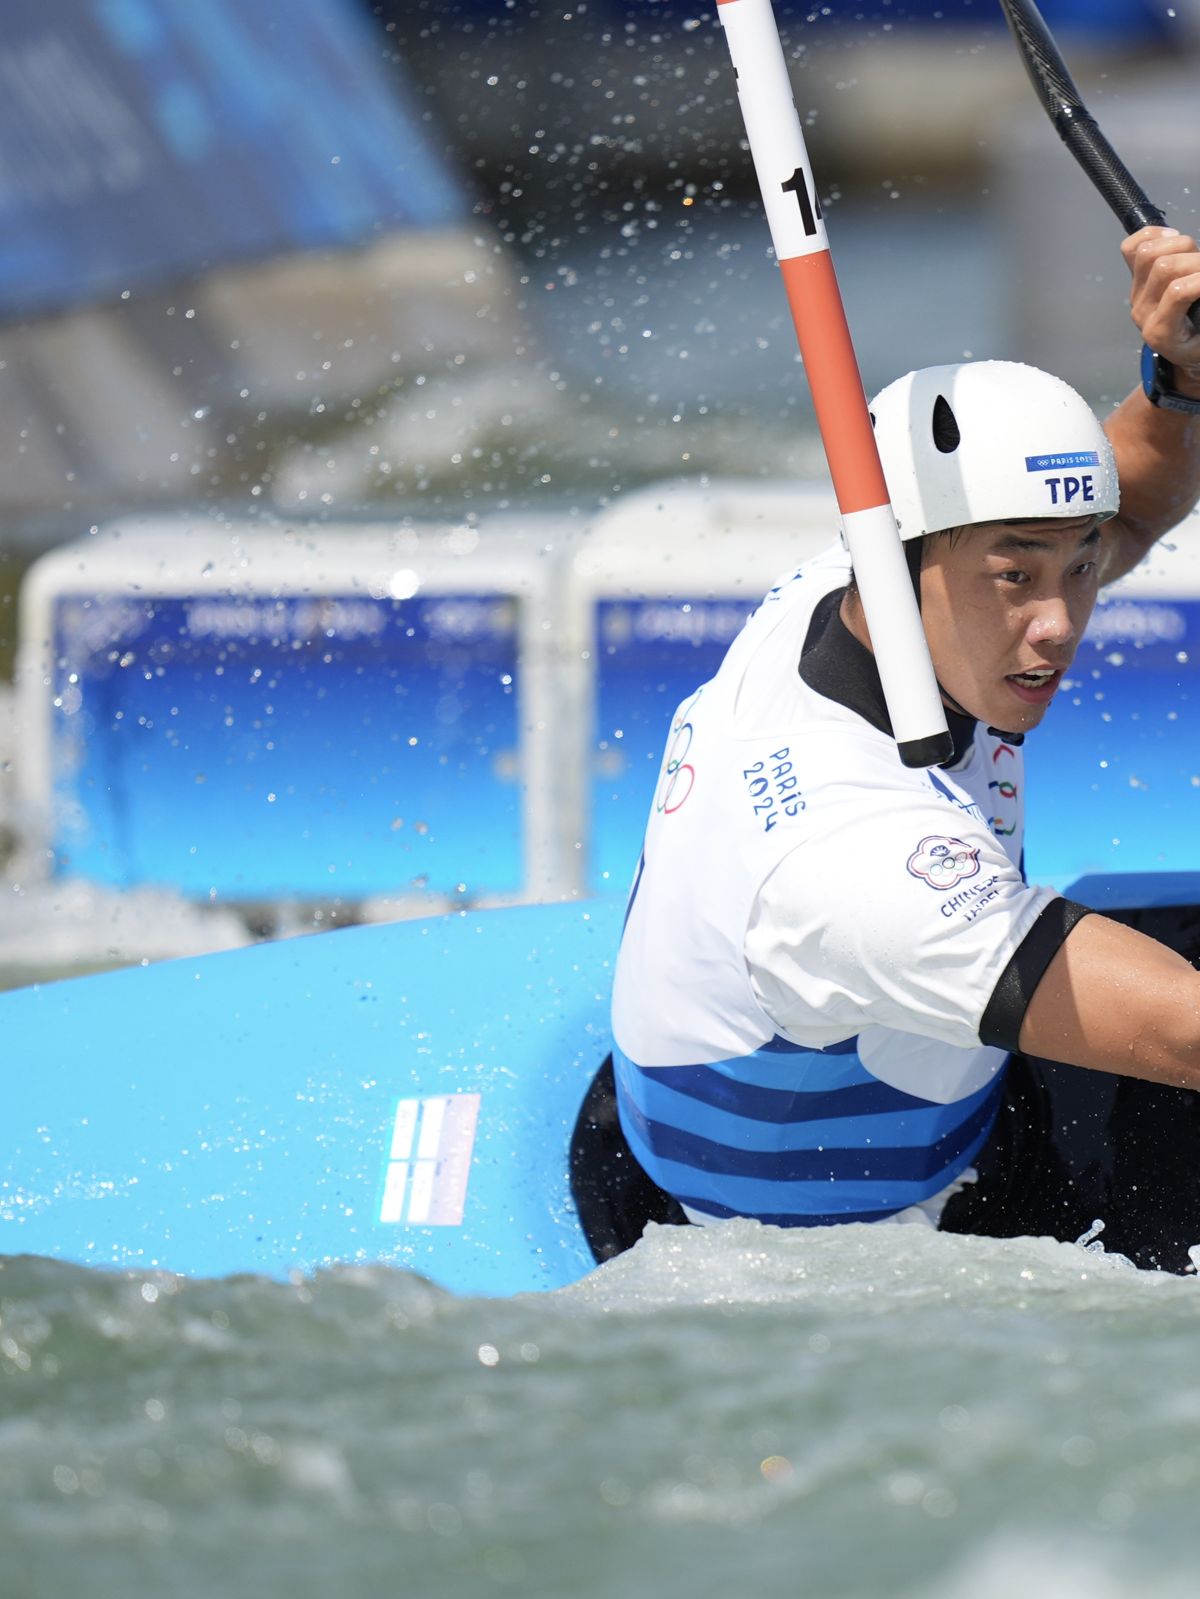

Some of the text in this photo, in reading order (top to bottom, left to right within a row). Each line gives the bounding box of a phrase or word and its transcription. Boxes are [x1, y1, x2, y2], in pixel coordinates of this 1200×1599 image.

[781, 167, 822, 236] 1
[1045, 475, 1094, 504] TPE
[743, 761, 778, 832] 2024
